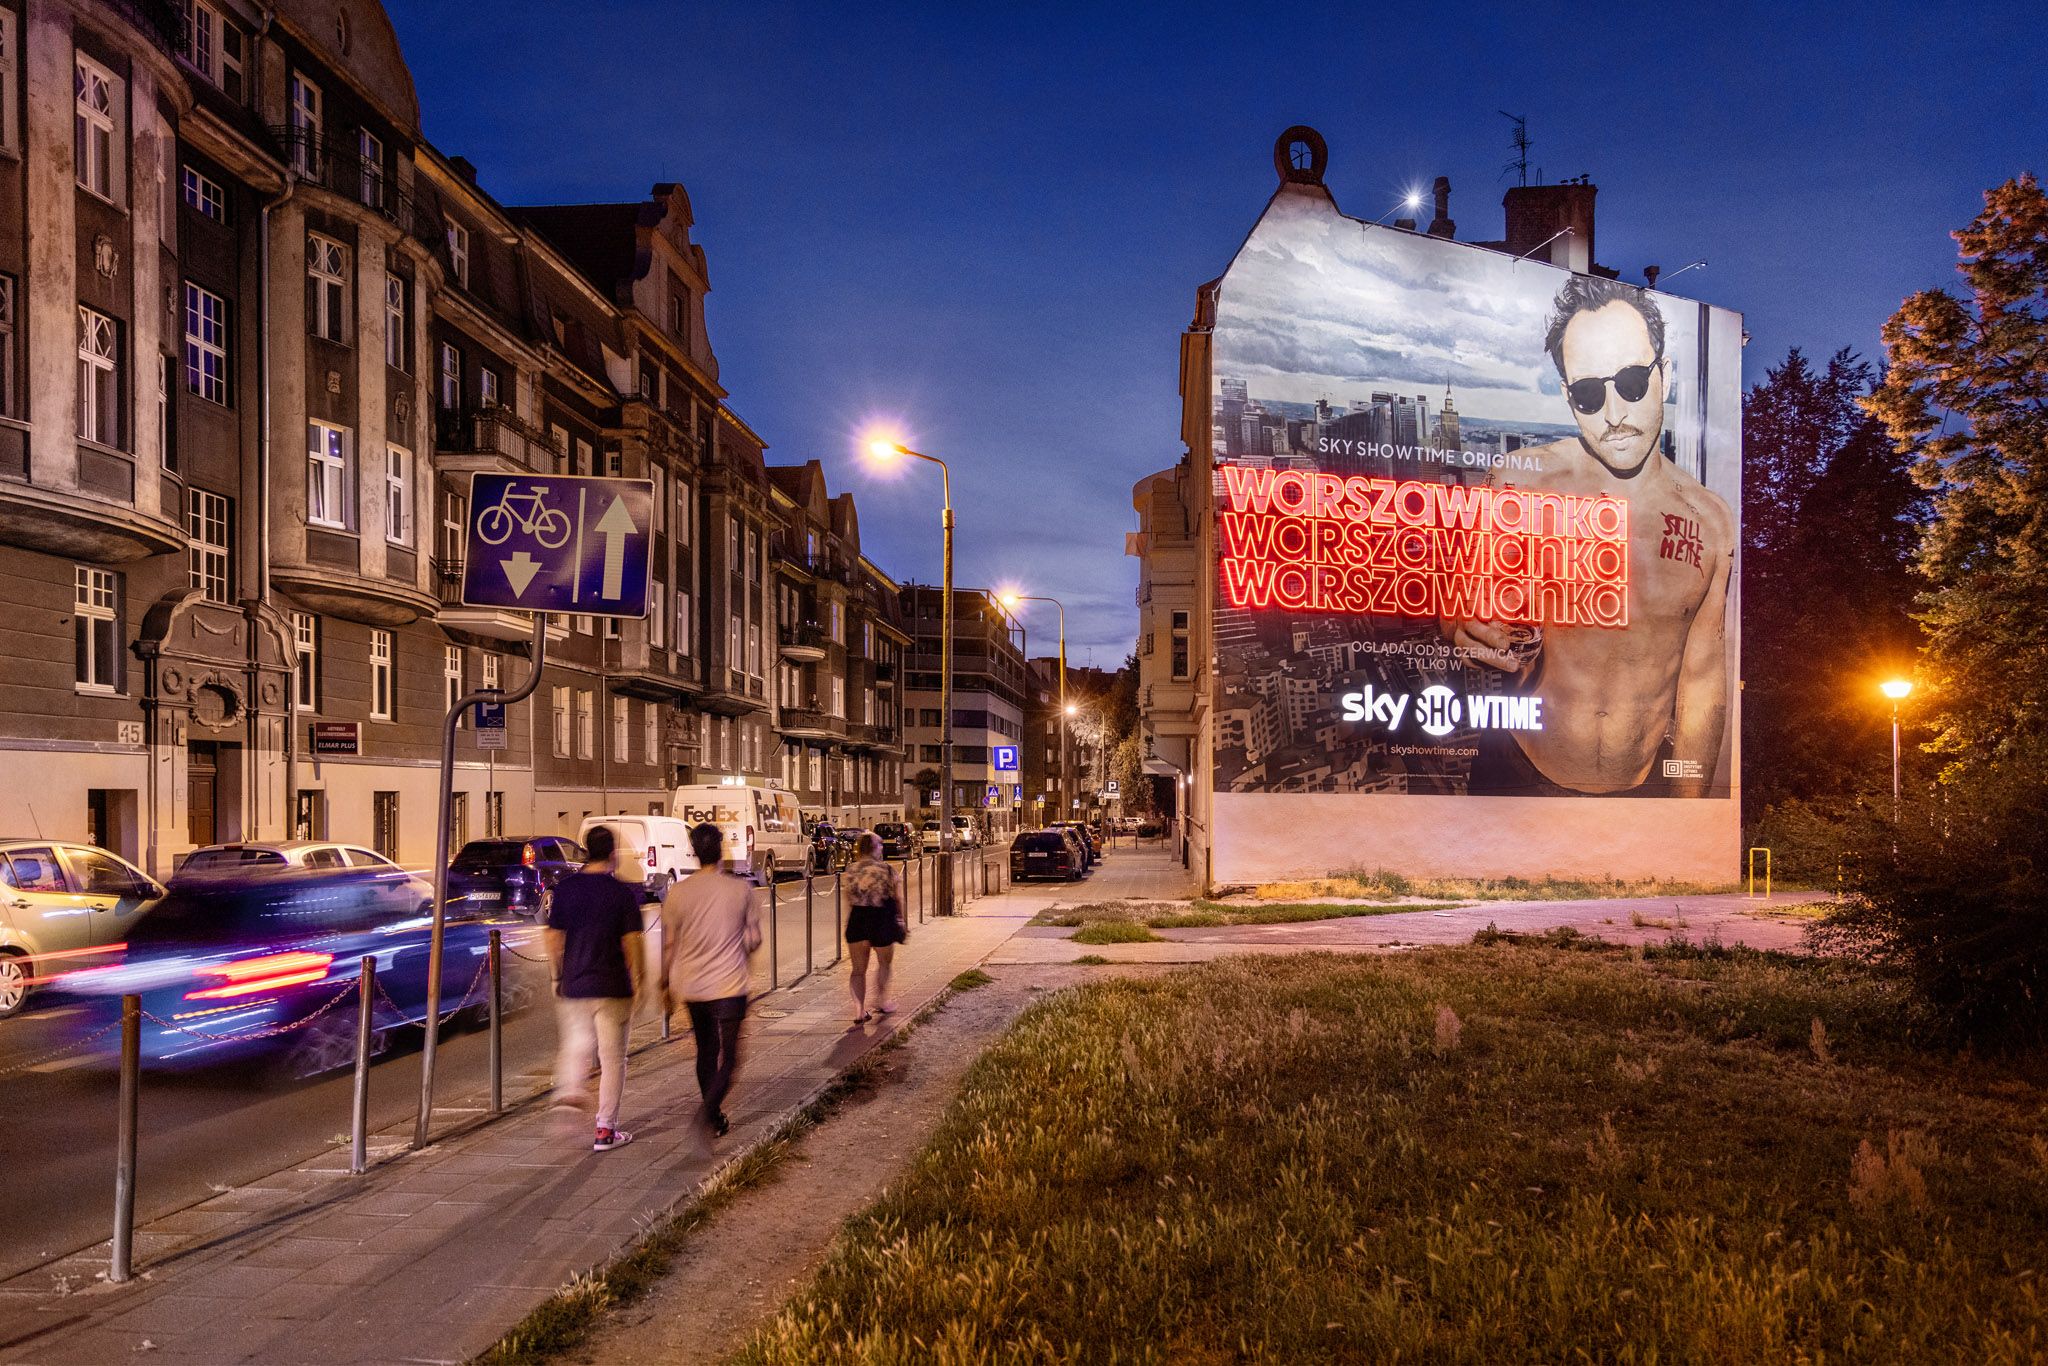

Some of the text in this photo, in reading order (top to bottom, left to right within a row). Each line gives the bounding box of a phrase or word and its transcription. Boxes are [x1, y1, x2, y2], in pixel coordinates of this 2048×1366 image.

[1319, 437, 1543, 472] SKY SHOWTIME ORIGINAL
[1660, 511, 1703, 544] STILL
[1660, 537, 1704, 569] HERE
[1351, 640, 1515, 660] OGLĄDAJ OD 19 CZERWCA
[1406, 657, 1463, 672] TYLKO W
[1341, 684, 1410, 731] sky
[999, 749, 1013, 769] P
[1391, 744, 1479, 756] skyshowtime.com
[1108, 781, 1117, 792] P
[684, 805, 740, 823] FedEx
